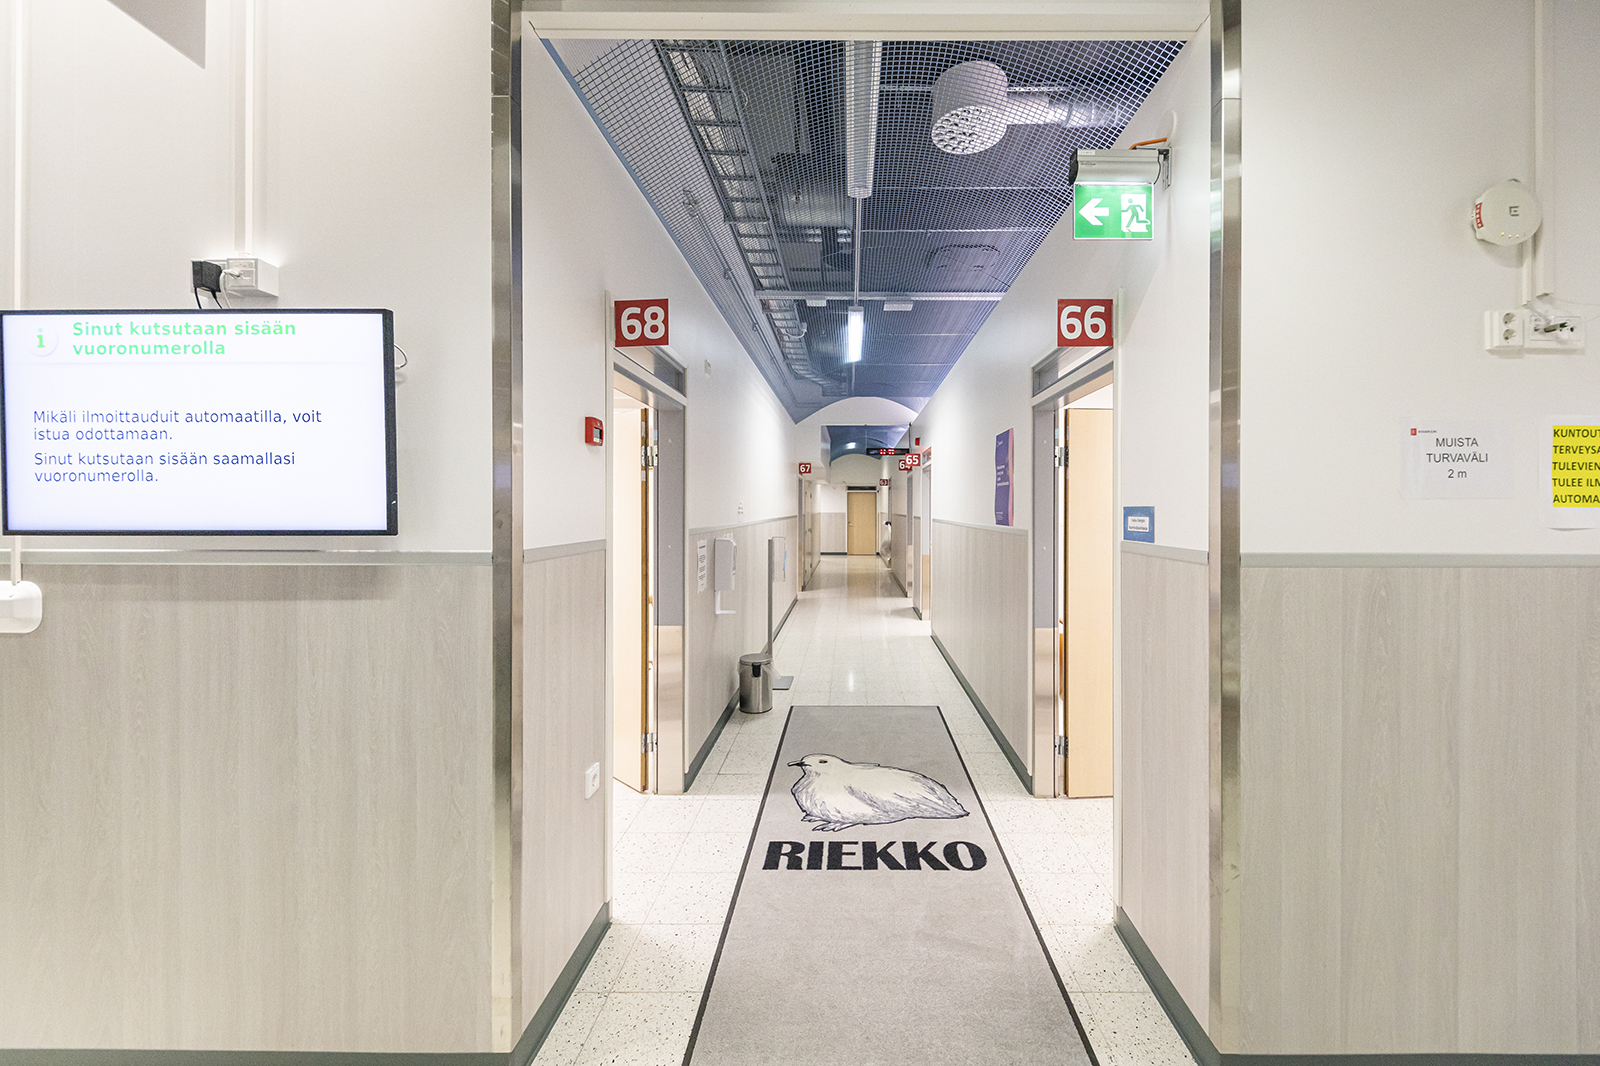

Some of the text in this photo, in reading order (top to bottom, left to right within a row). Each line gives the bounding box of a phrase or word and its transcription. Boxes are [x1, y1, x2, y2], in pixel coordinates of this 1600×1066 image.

[72, 320, 297, 336] Sinut kutsutaan sisään
[620, 306, 666, 341] 68
[1060, 305, 1106, 339] 66
[72, 340, 226, 356] vuoronumerolla
[33, 409, 323, 426] Mikäli ilmoittauduit automaatilla, voit
[33, 426, 173, 441] istua odottamaan.
[1435, 437, 1479, 448] MUISTA
[34, 451, 296, 466] Sinut kutsutaan sisään saamallasi
[906, 455, 919, 465] 65
[1426, 451, 1489, 463] TURVAVÄLI
[800, 464, 811, 473] 67
[899, 460, 911, 470] 6
[34, 468, 159, 483] vuoronumerolla.
[1447, 468, 1467, 479] 2 m
[1552, 477, 1583, 488] TULEE
[762, 840, 988, 872] RIEKKO
